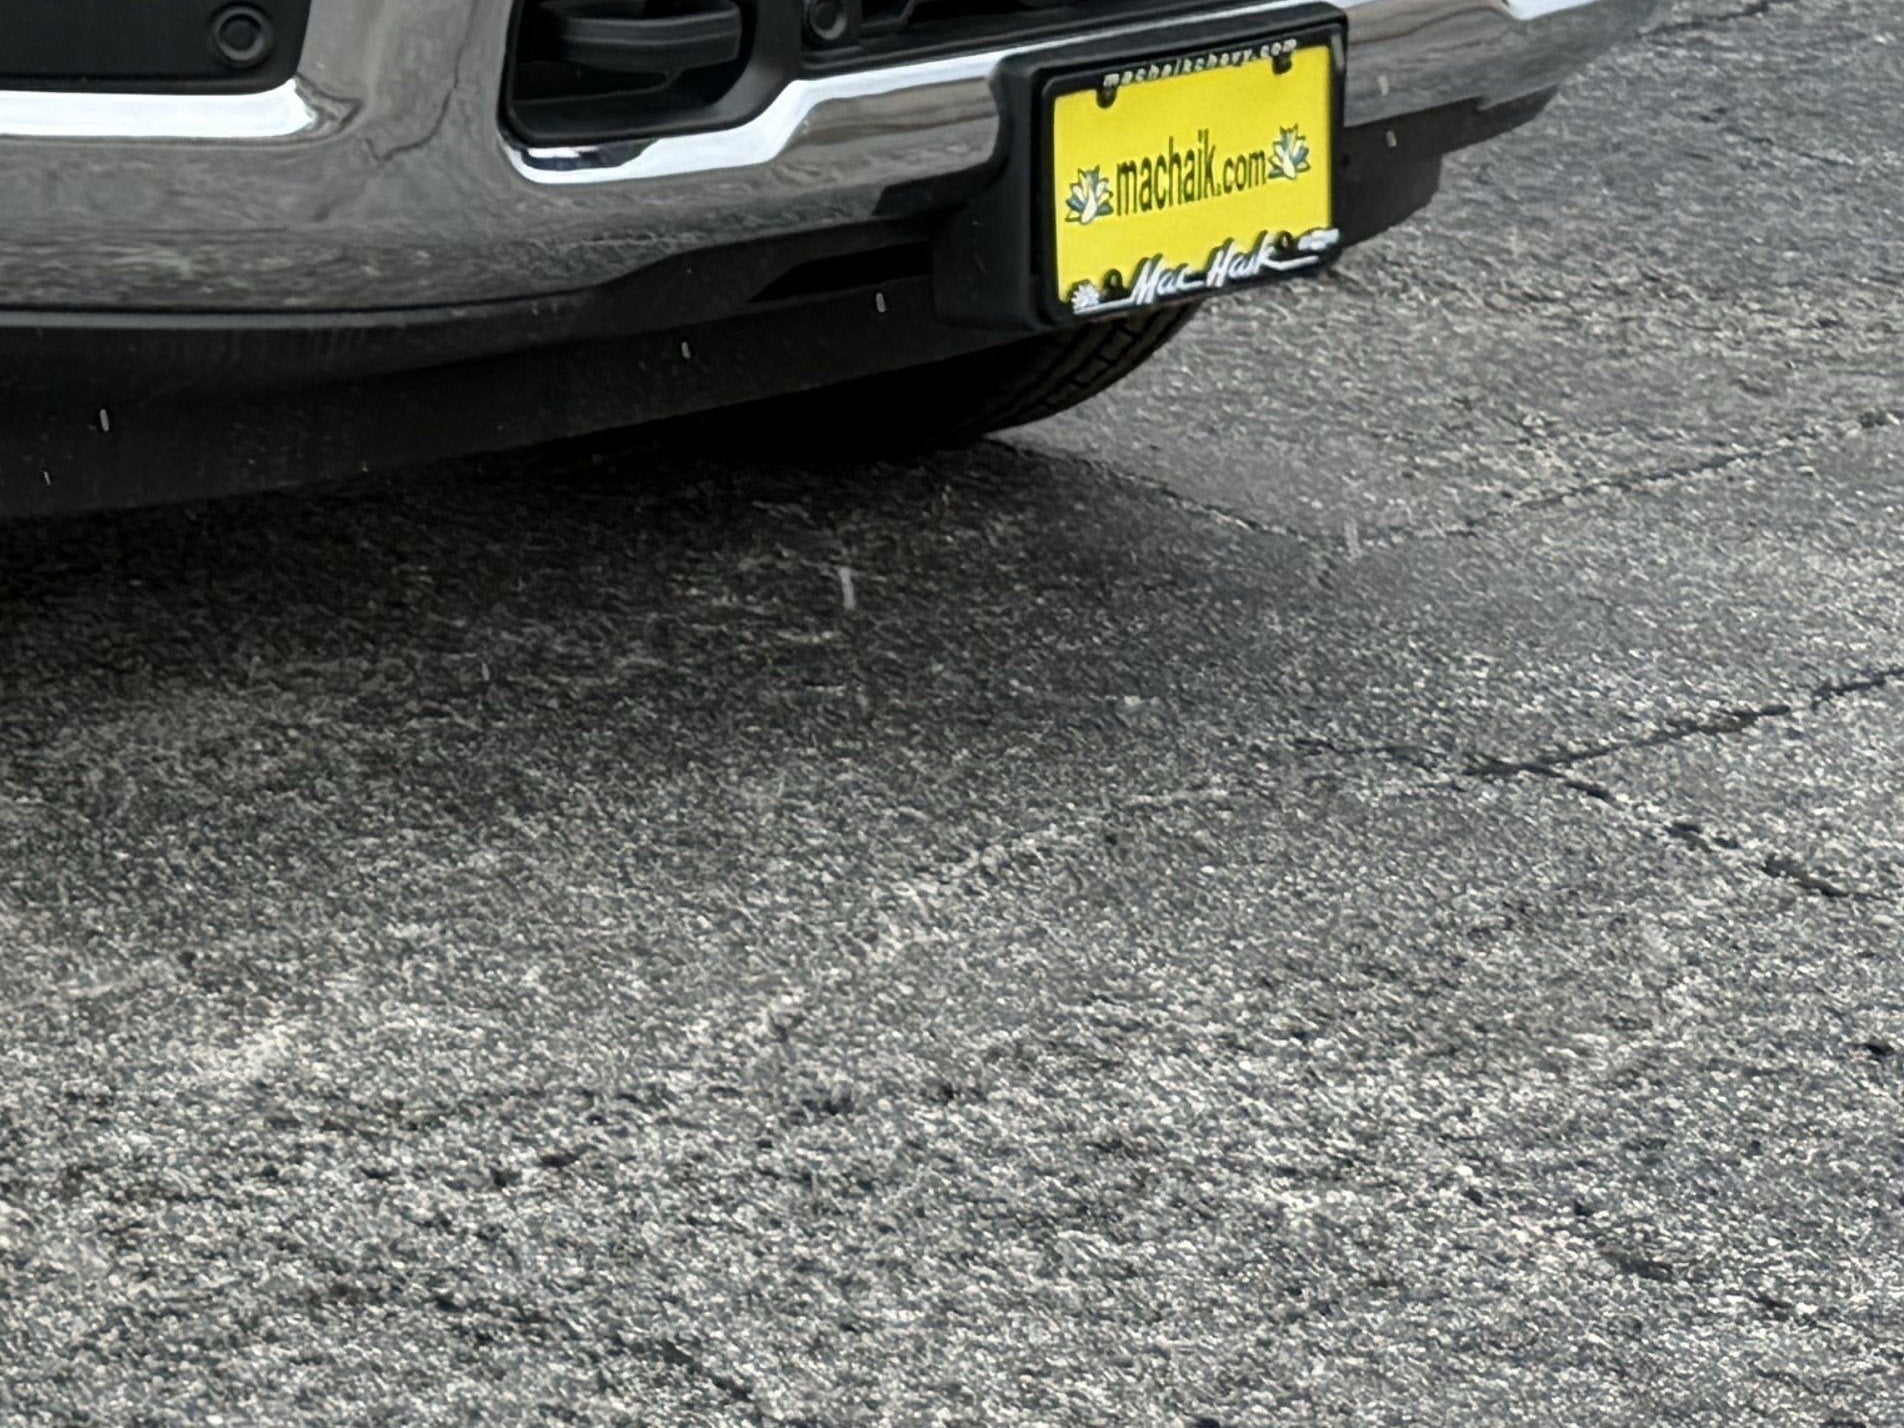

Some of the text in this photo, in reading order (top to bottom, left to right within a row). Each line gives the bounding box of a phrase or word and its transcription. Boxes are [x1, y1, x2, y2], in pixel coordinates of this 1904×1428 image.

[1115, 129, 1268, 217] machaik.com
[1130, 233, 1290, 305] Mac Haik
